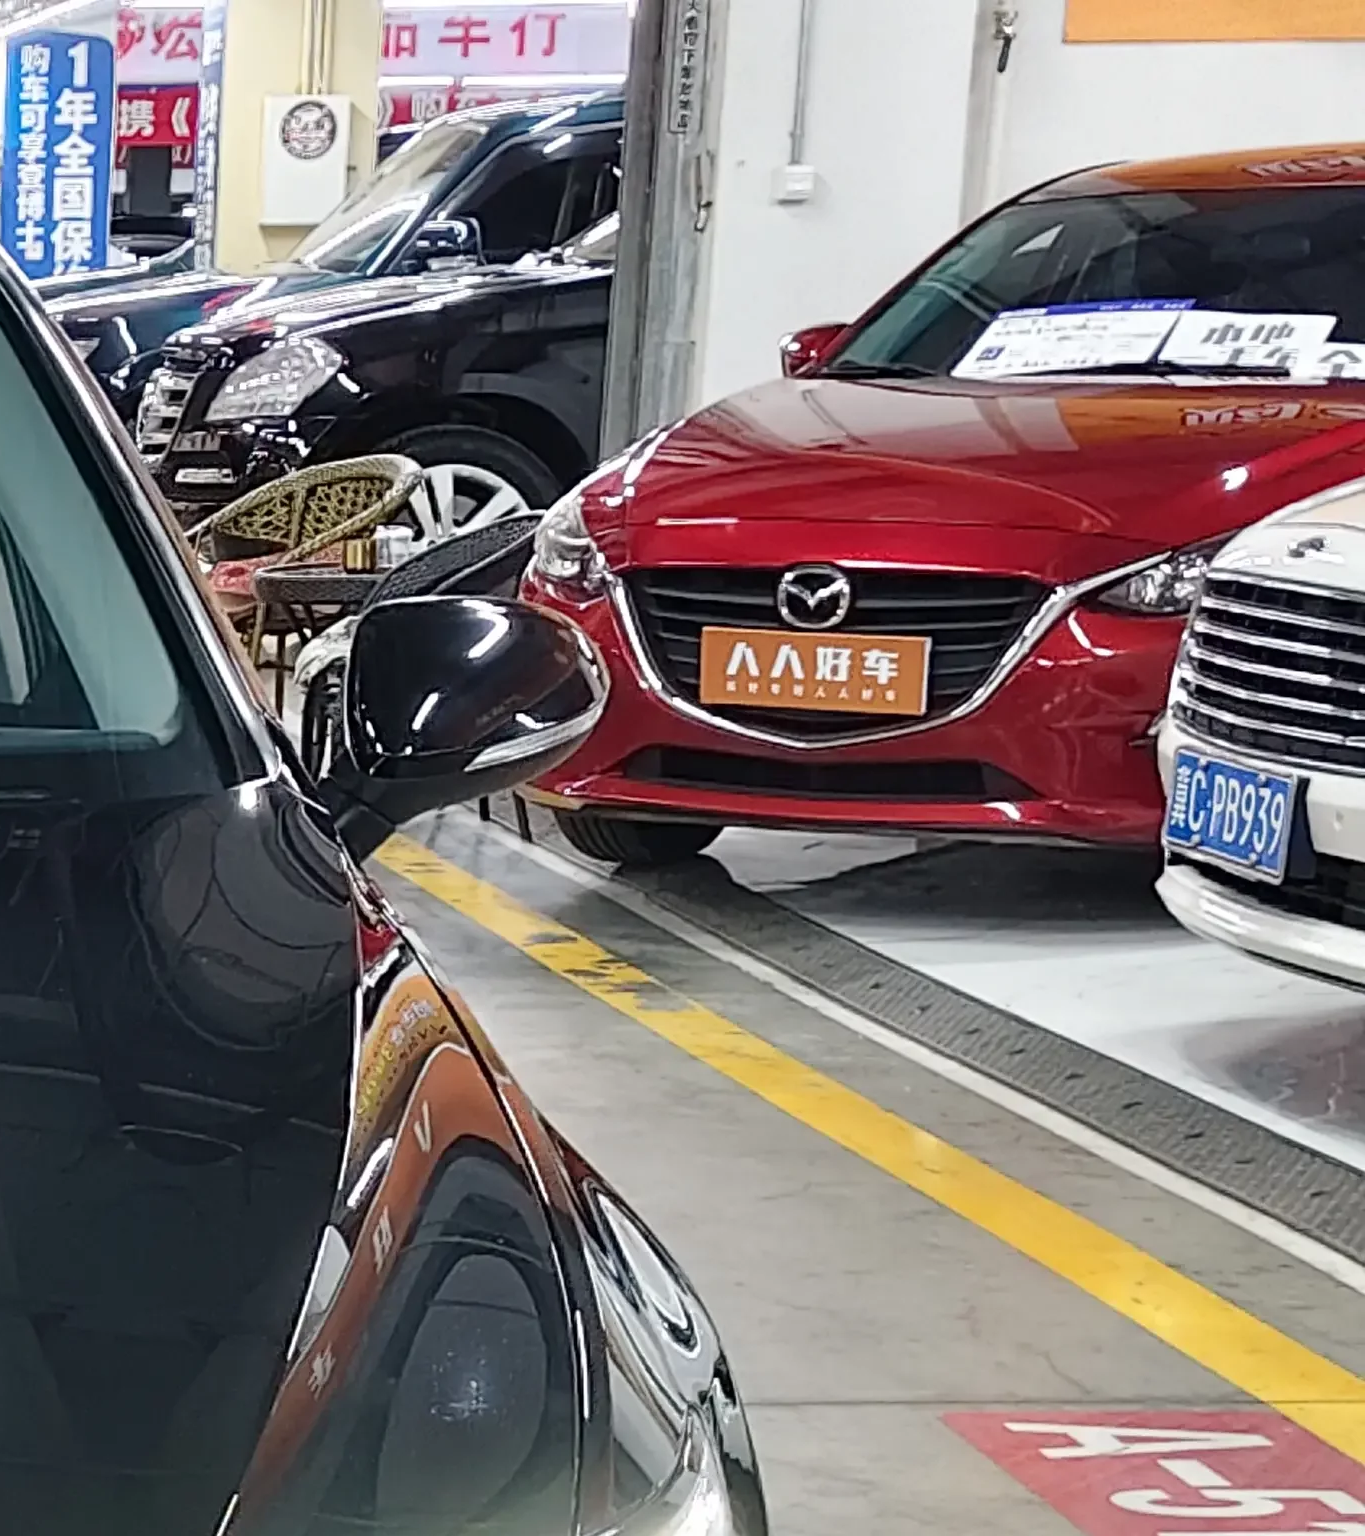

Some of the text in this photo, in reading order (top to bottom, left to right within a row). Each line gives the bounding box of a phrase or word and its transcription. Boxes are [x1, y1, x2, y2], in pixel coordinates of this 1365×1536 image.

[50, 40, 98, 276] 1年全国保
[726, 641, 899, 685] 人人好车
